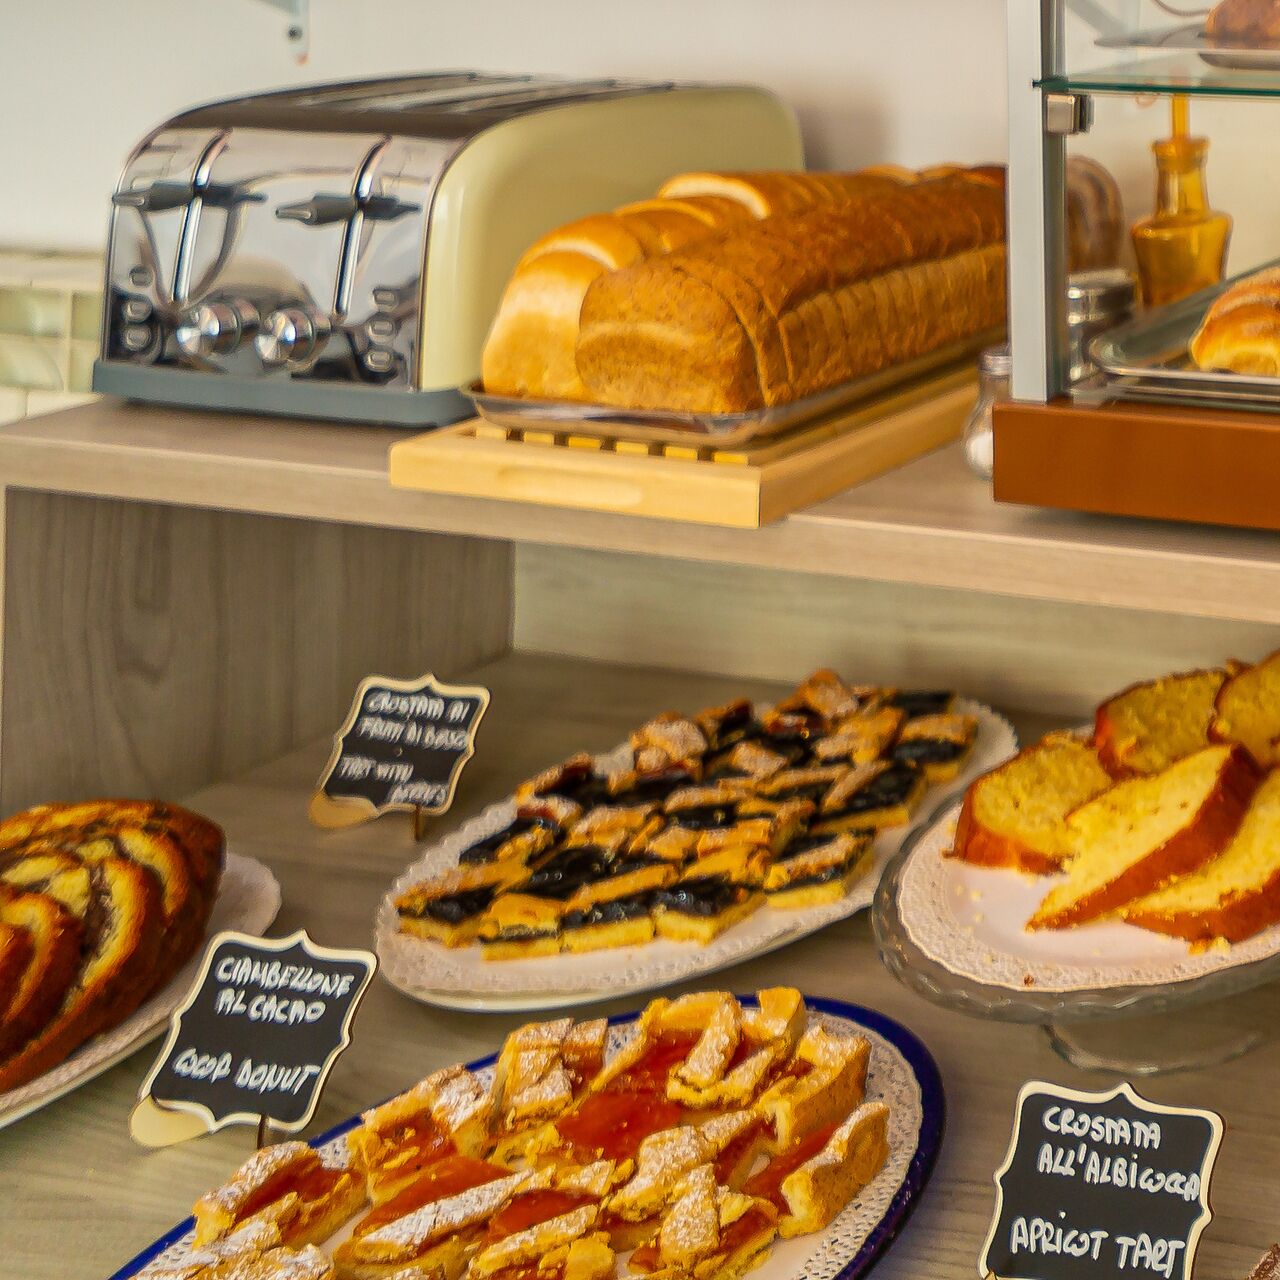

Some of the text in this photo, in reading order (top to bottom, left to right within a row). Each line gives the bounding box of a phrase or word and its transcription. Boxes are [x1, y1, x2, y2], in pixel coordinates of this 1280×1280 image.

[234, 1056, 322, 1096] DONUT
[1041, 1105, 1162, 1150] CROSTATA
[1009, 1209, 1187, 1280] APRICOT TART
